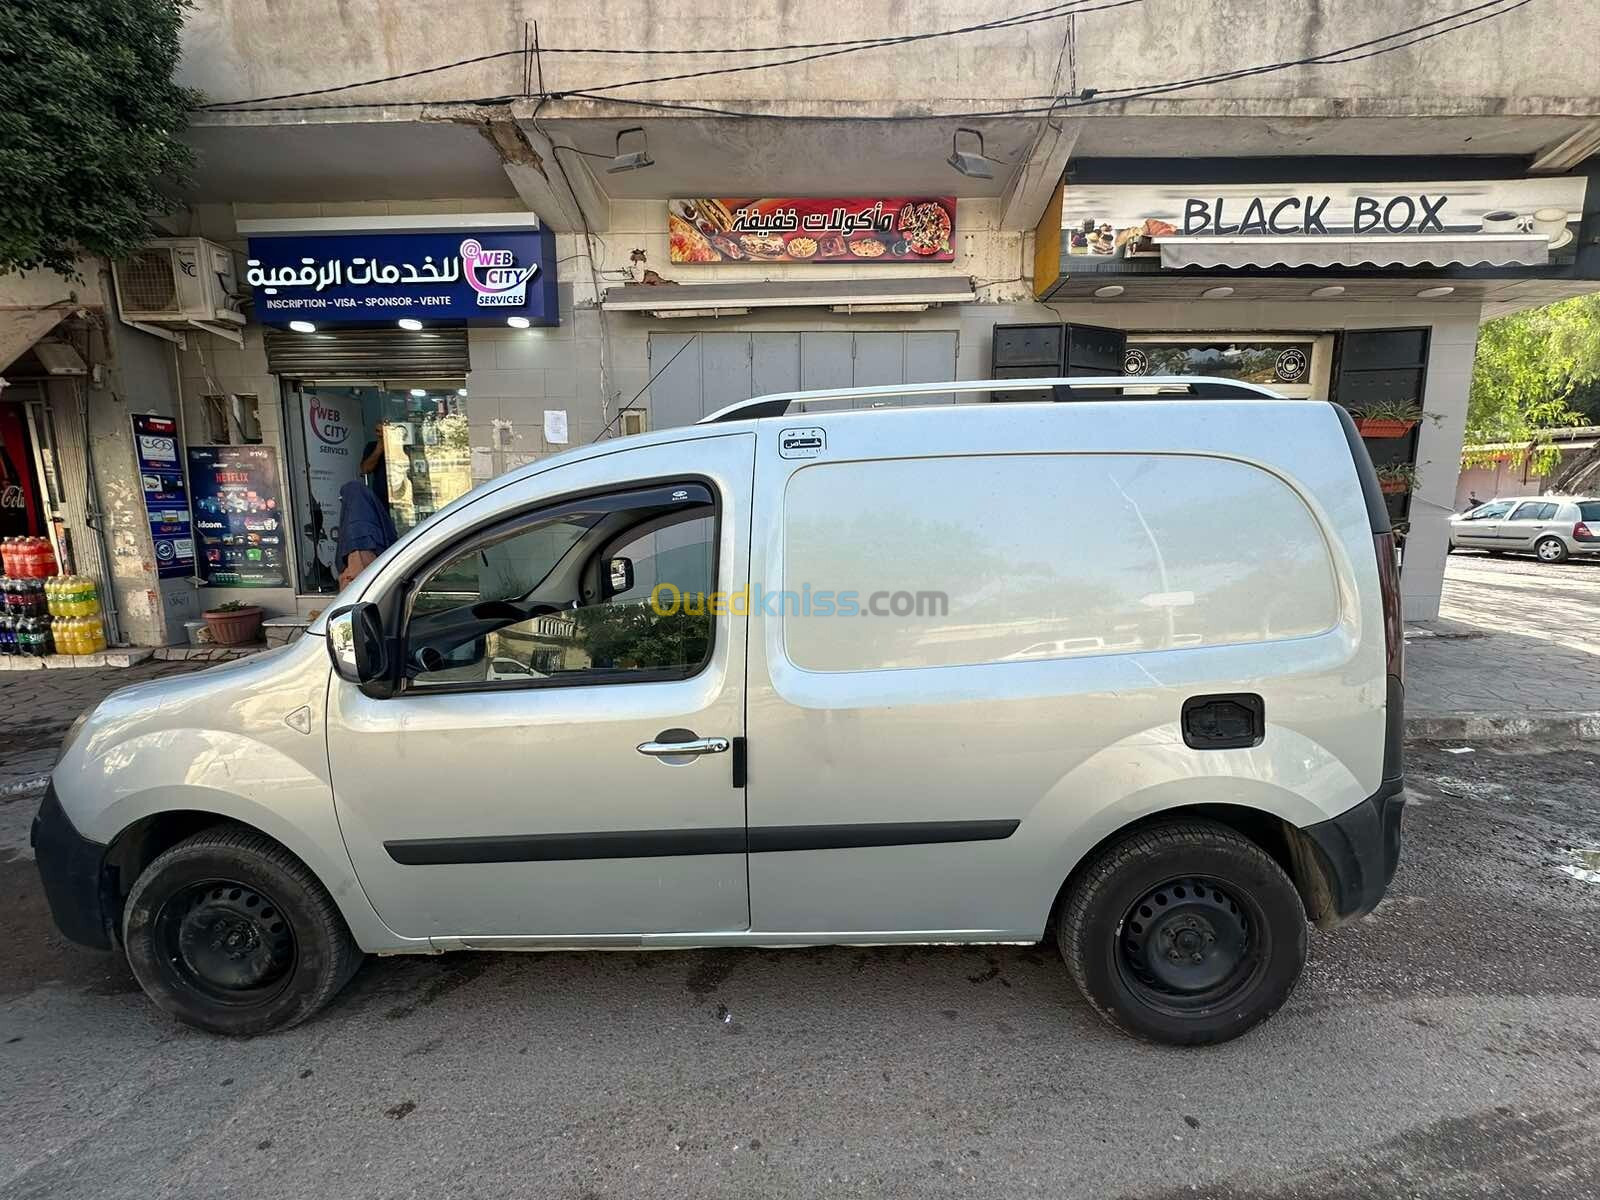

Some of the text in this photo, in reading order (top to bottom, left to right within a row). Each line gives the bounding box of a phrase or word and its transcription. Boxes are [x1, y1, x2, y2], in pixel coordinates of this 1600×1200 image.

[732, 201, 895, 237] مأكولات خفيفة
[1184, 193, 1450, 235] BLACK BOX
[477, 252, 512, 266] WEB
[246, 255, 459, 295] للخدمات الرقمية
[488, 270, 524, 284] CITY
[266, 299, 327, 310] INSCRIPTION
[333, 298, 357, 308] VISA
[365, 297, 412, 307] SPONSOR
[419, 295, 452, 306] VENTE
[478, 295, 524, 305] SERVICES
[1281, 350, 1302, 360] BLACK
[316, 408, 341, 422] WEB
[323, 424, 350, 439] CITY
[320, 445, 349, 456] SERVICES
[216, 472, 249, 483] NETFLIX
